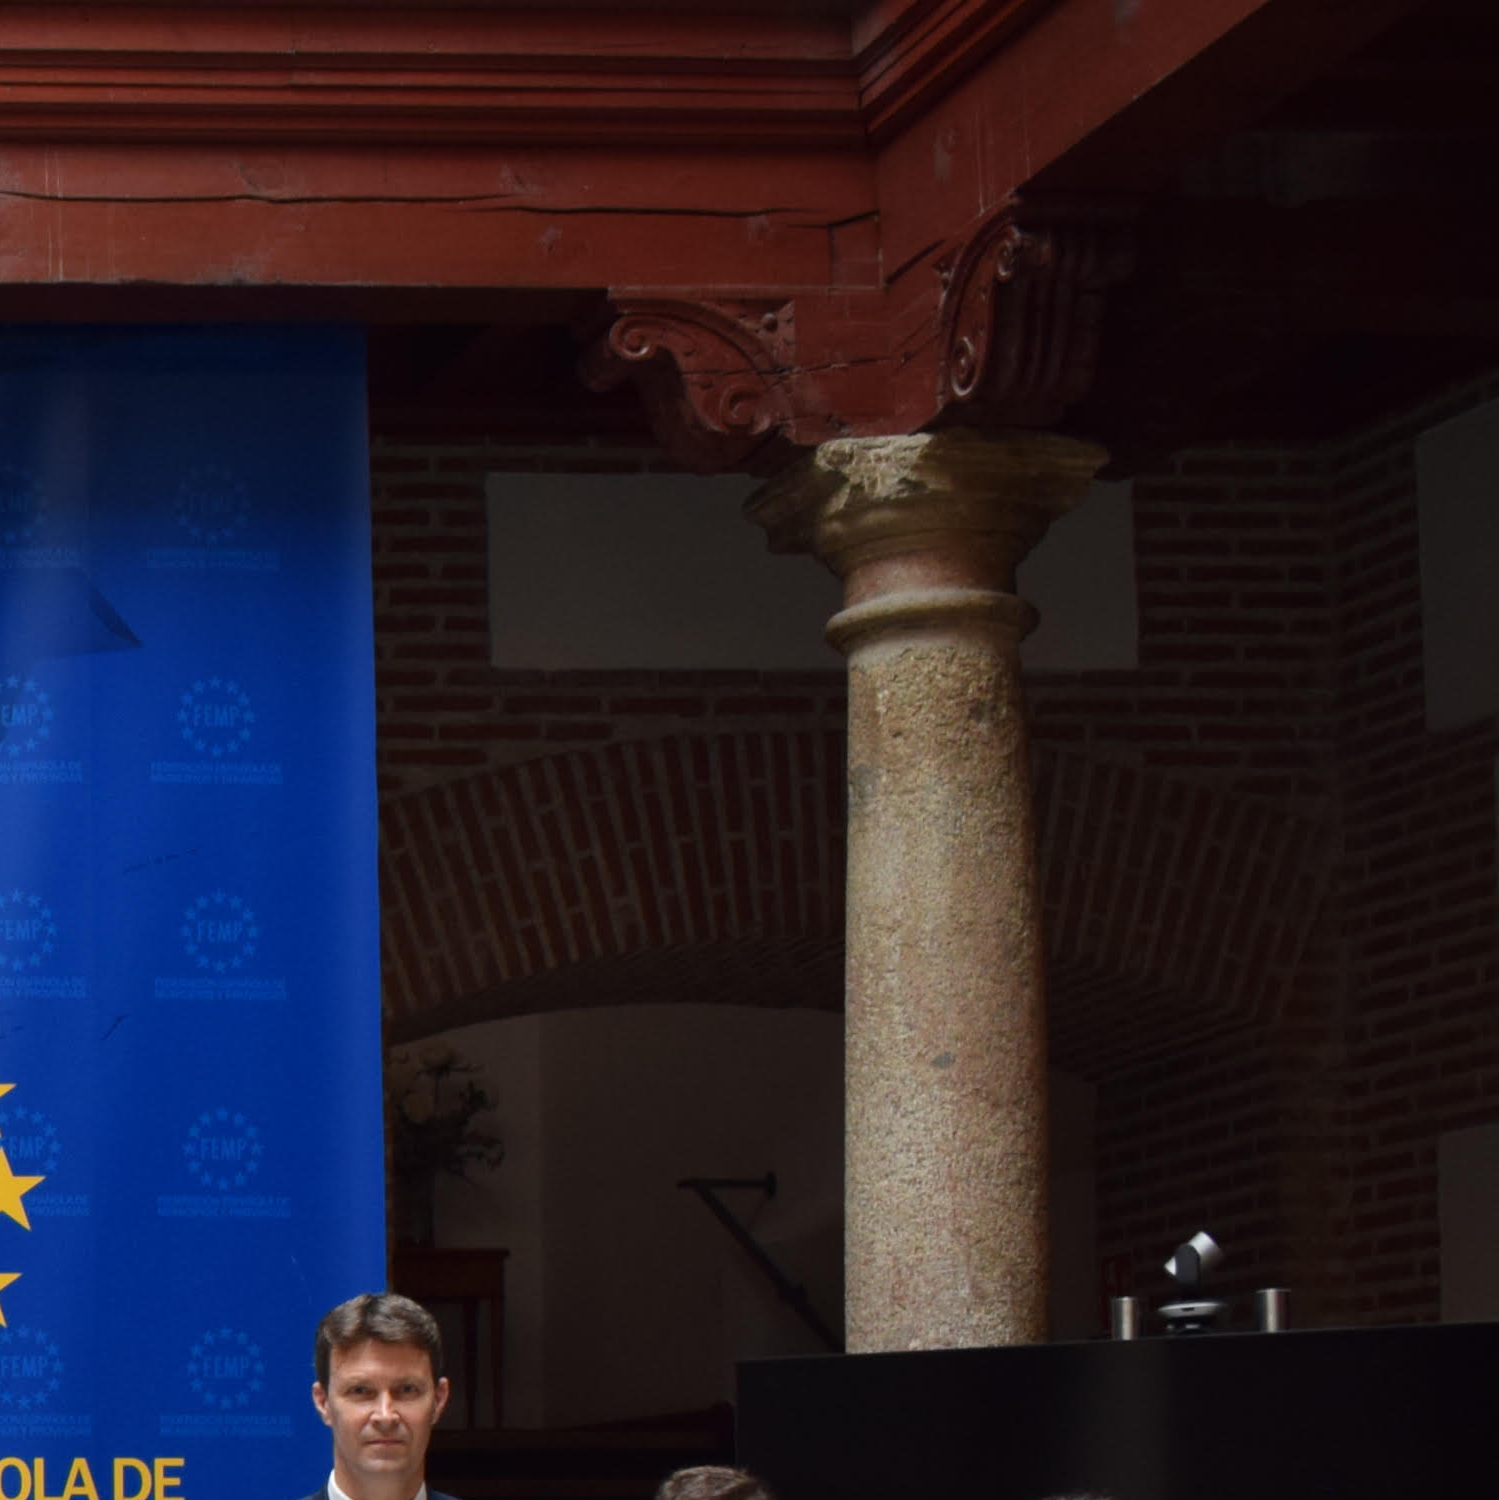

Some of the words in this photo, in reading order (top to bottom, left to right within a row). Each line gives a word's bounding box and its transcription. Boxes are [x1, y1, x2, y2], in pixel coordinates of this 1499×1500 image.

[193, 704, 241, 727] FEMP
[197, 920, 245, 943] FEMP
[200, 1137, 248, 1160] FEMP
[1, 1355, 49, 1378] FEMP
[203, 1356, 251, 1379] FEMP
